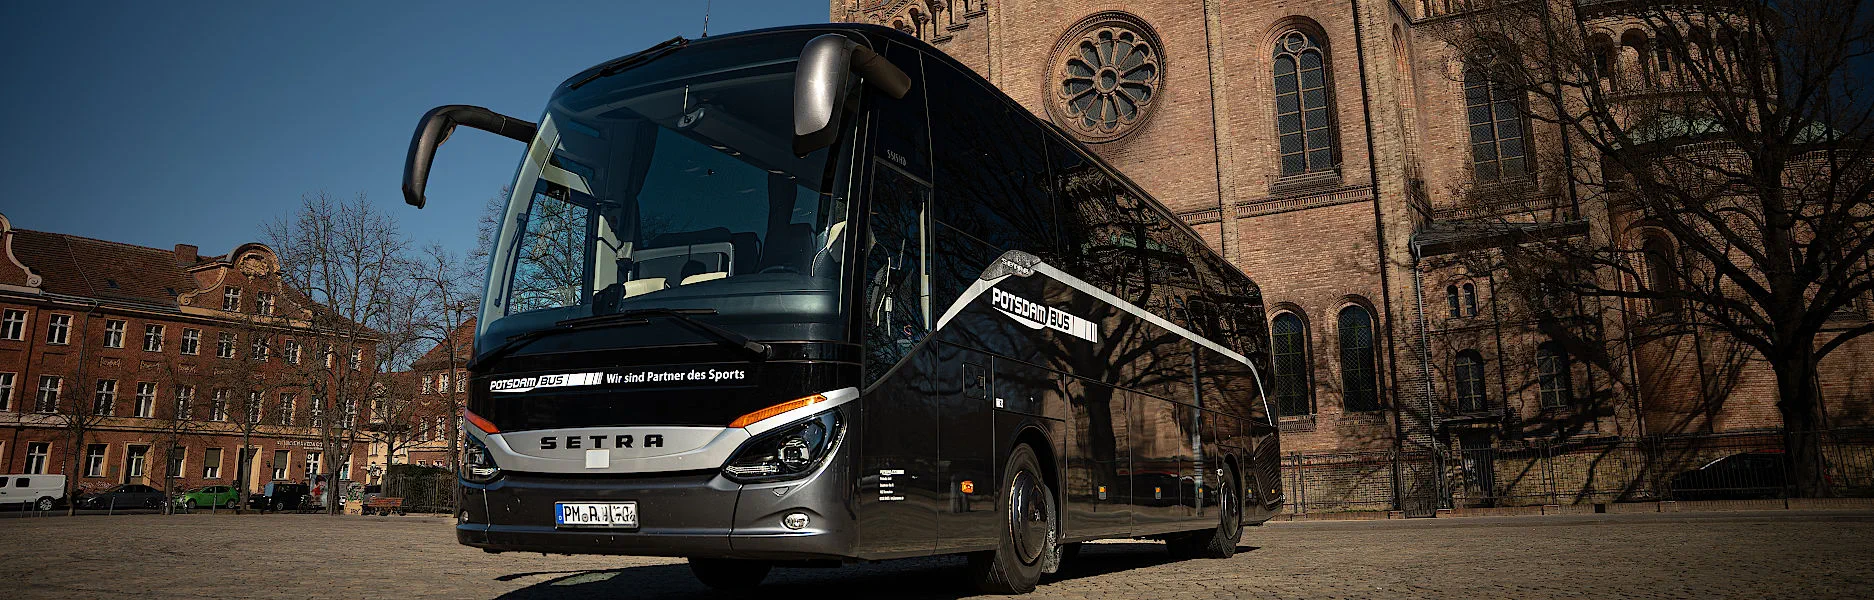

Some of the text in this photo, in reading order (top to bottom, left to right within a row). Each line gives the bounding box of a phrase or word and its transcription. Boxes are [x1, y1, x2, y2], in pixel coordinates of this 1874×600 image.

[992, 287, 1070, 331] POTSDAM BUS
[490, 369, 745, 391] POTSDAM BUS Wir sind Partner des Sports
[540, 434, 664, 450] SETRA
